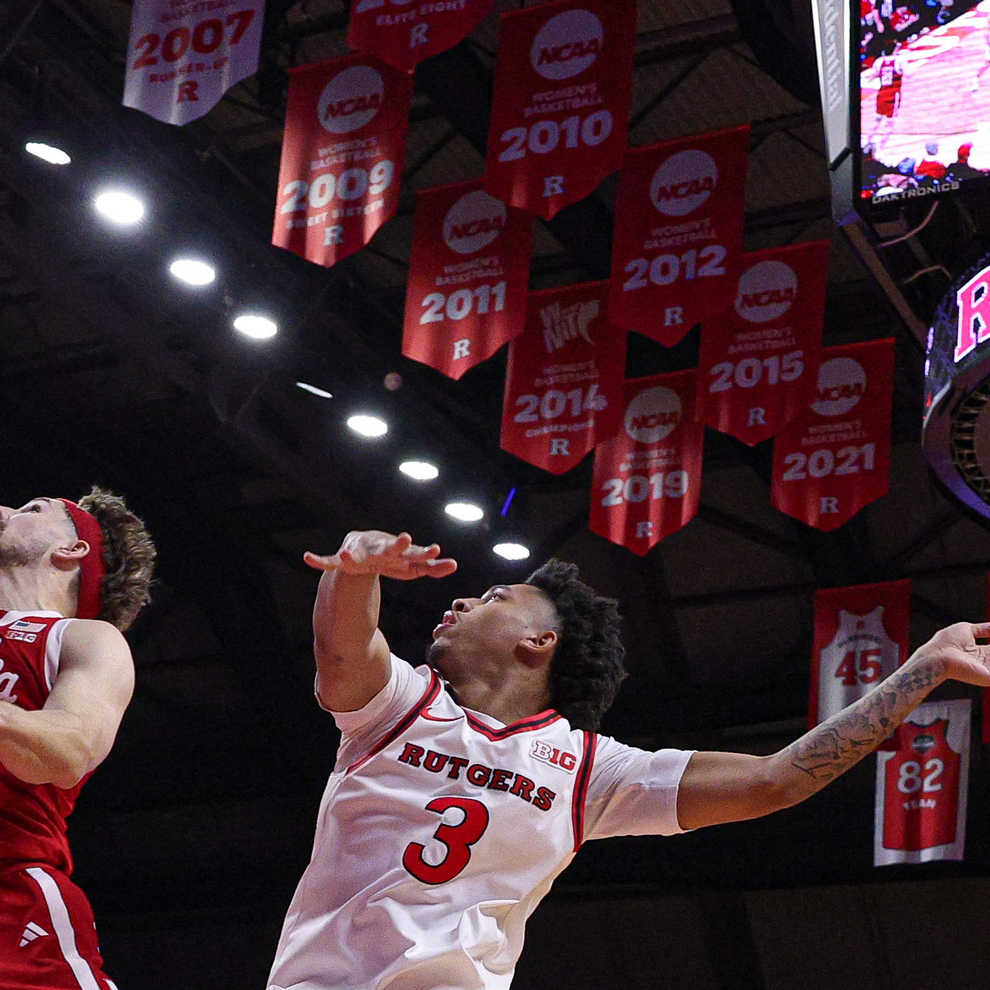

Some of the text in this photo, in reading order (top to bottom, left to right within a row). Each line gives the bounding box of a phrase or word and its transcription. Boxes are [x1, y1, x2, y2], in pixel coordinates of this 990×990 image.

[133, 9, 255, 70] 2007
[409, 22, 430, 48] R
[538, 38, 603, 66] NCAA
[177, 81, 199, 103] R
[324, 92, 385, 121] NCAA
[498, 109, 613, 163] 2010
[280, 159, 395, 214] 2009
[542, 175, 565, 197] R
[657, 175, 717, 202] NCAA
[323, 225, 345, 246] R
[449, 216, 506, 240] NCAA
[622, 244, 728, 292] 2012
[419, 281, 508, 325] 2011
[741, 287, 798, 308] NCAA
[663, 305, 685, 327] R
[954, 264, 990, 363] R
[453, 338, 471, 360] R
[709, 350, 804, 393] 2015
[513, 384, 609, 424] 2014
[746, 406, 767, 427] R
[632, 411, 683, 430] NCAA
[549, 438, 571, 456] R
[782, 442, 876, 481] 2021
[601, 470, 690, 507] 2019
[819, 496, 840, 514] R
[635, 520, 654, 539] R
[835, 647, 883, 686] 45
[397, 741, 557, 812] RUTGERS
[896, 756, 946, 795] 82
[402, 796, 490, 885] 3
